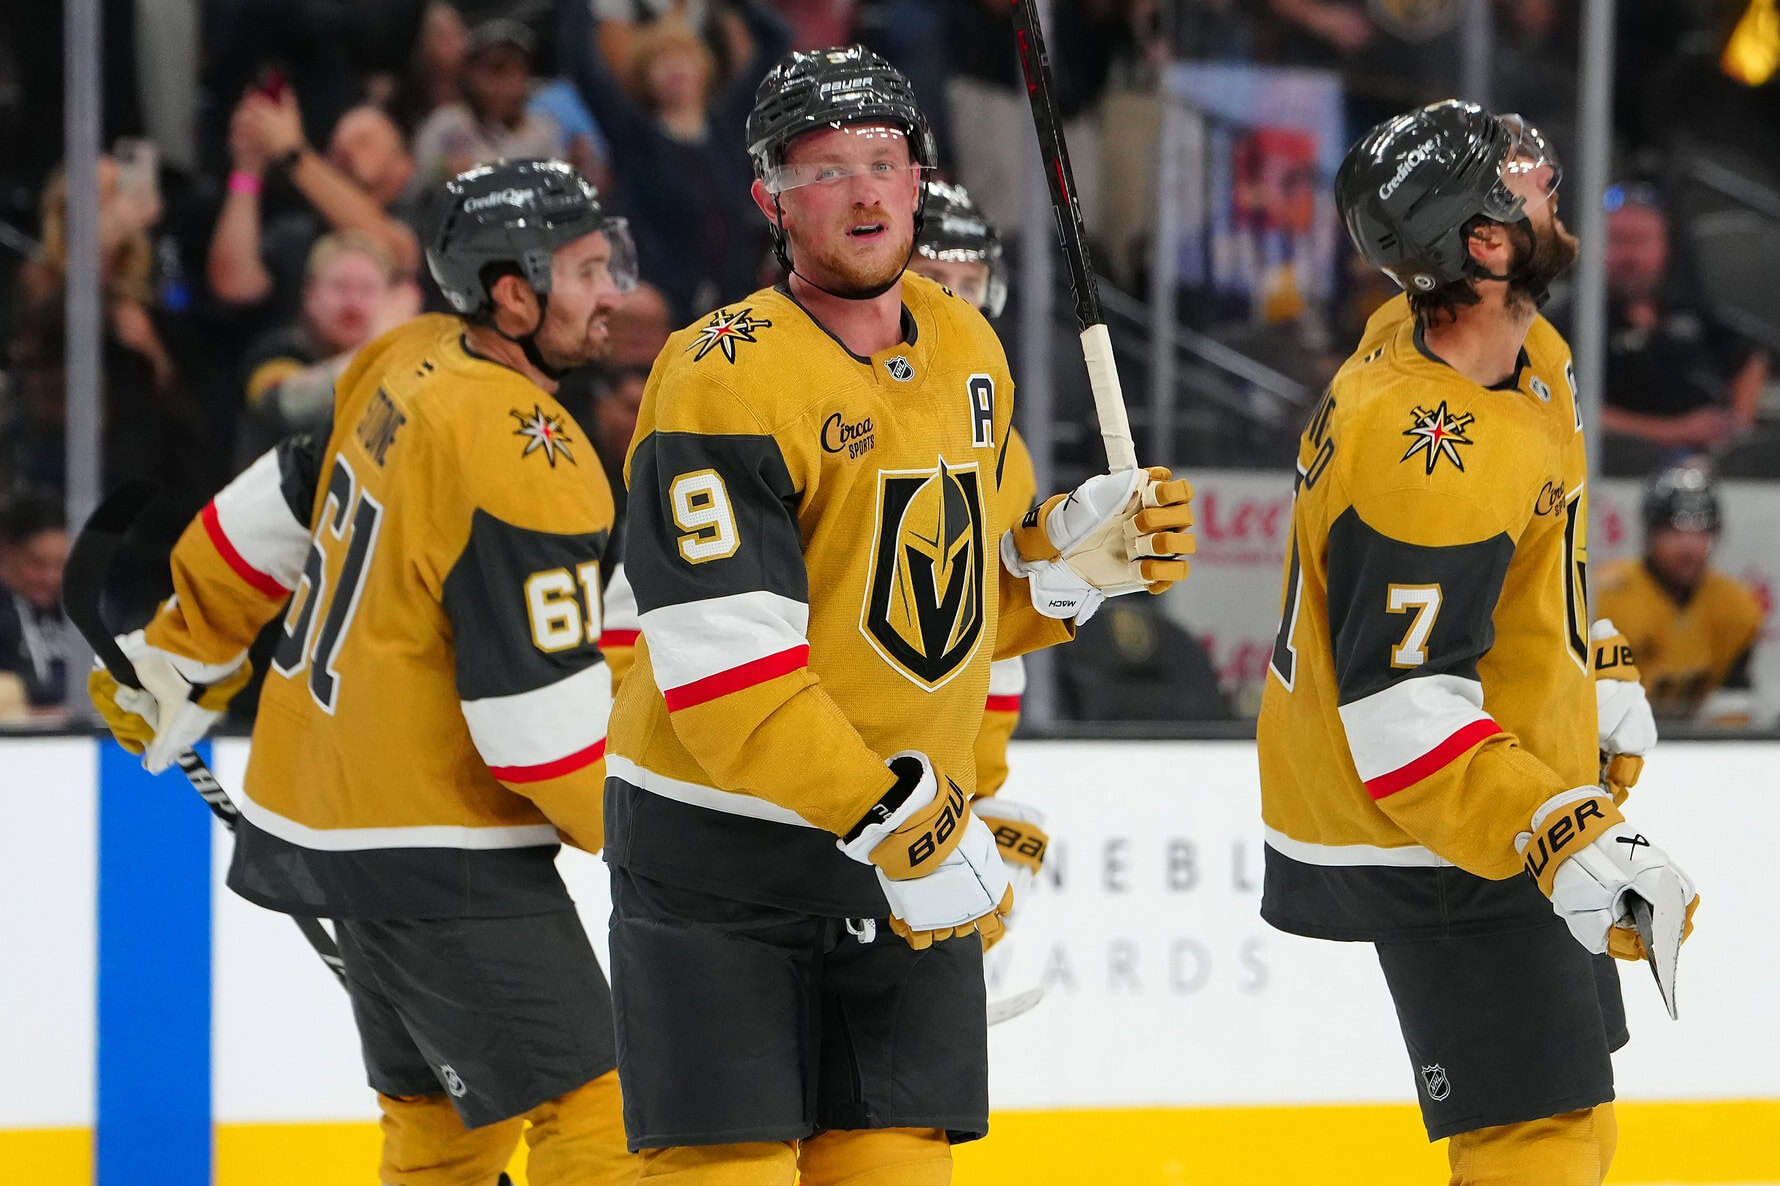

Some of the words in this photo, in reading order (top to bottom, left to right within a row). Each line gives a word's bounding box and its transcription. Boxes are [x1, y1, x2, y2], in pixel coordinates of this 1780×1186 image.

[821, 412, 874, 453] Circa
[849, 435, 875, 460] SPORTS
[966, 373, 996, 449] A
[668, 468, 742, 566] 9
[523, 559, 602, 654] 61
[1048, 600, 1077, 608] MACH
[1386, 583, 1444, 670] 7
[1524, 800, 1605, 880] UER
